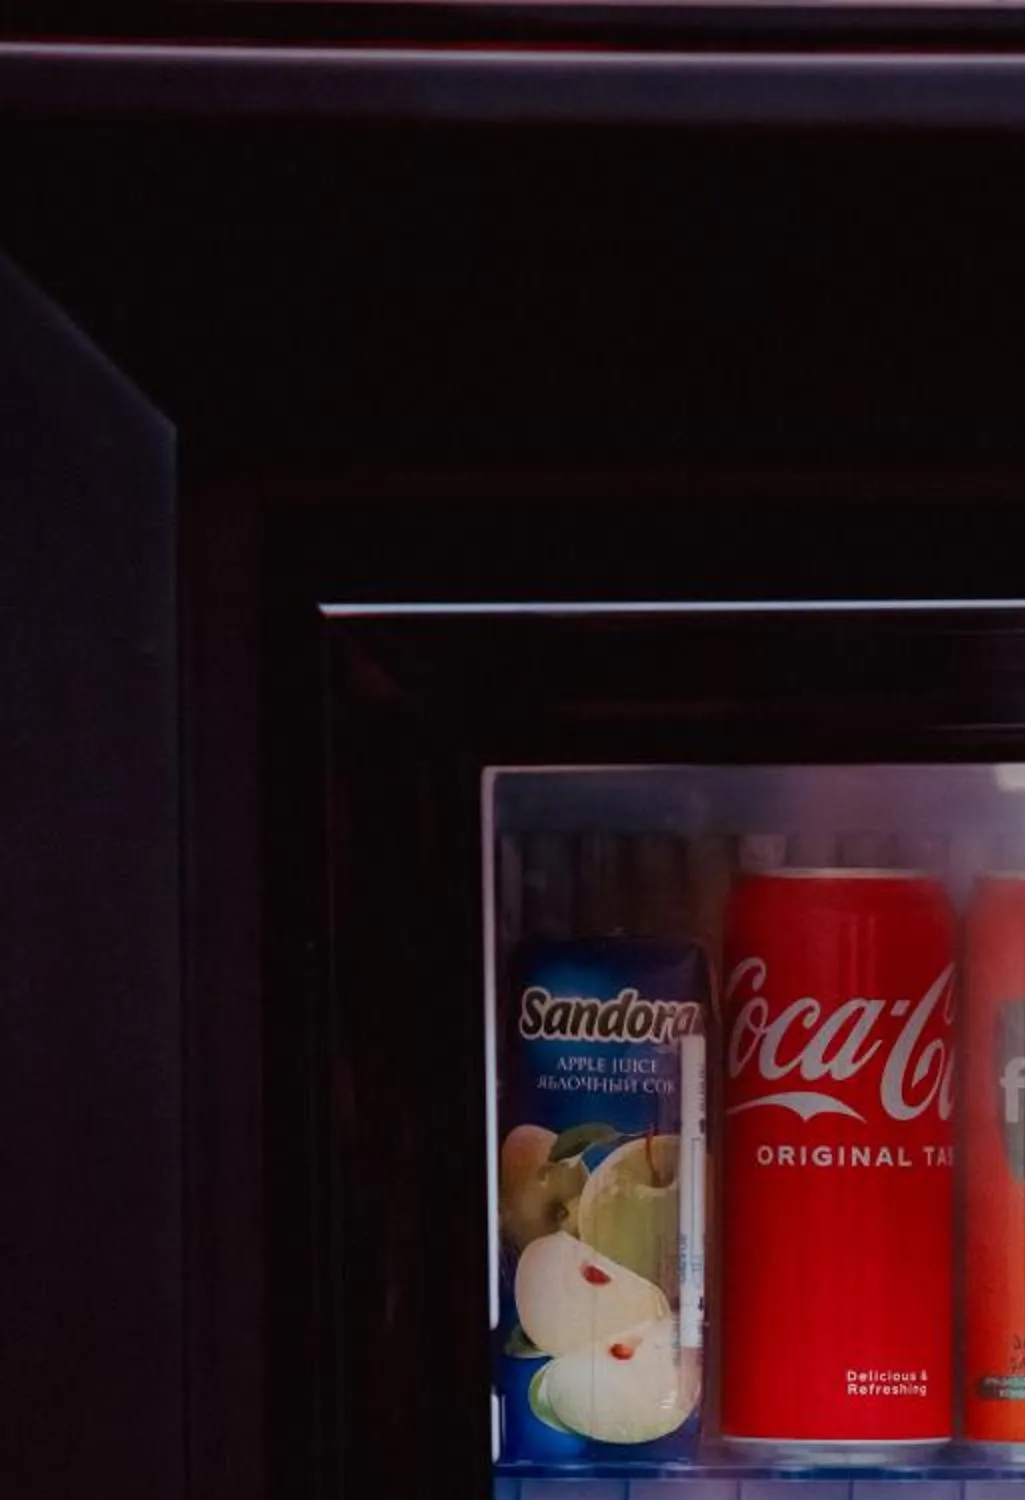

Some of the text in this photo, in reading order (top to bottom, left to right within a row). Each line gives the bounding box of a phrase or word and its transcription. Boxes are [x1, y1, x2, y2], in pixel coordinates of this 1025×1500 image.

[519, 986, 700, 1044] Sandora
[556, 1056, 607, 1072] APPLE
[756, 1145, 912, 1167] ORIGINAL
[846, 1369, 917, 1382] Delicious
[846, 1383, 928, 1397] Refreshing
